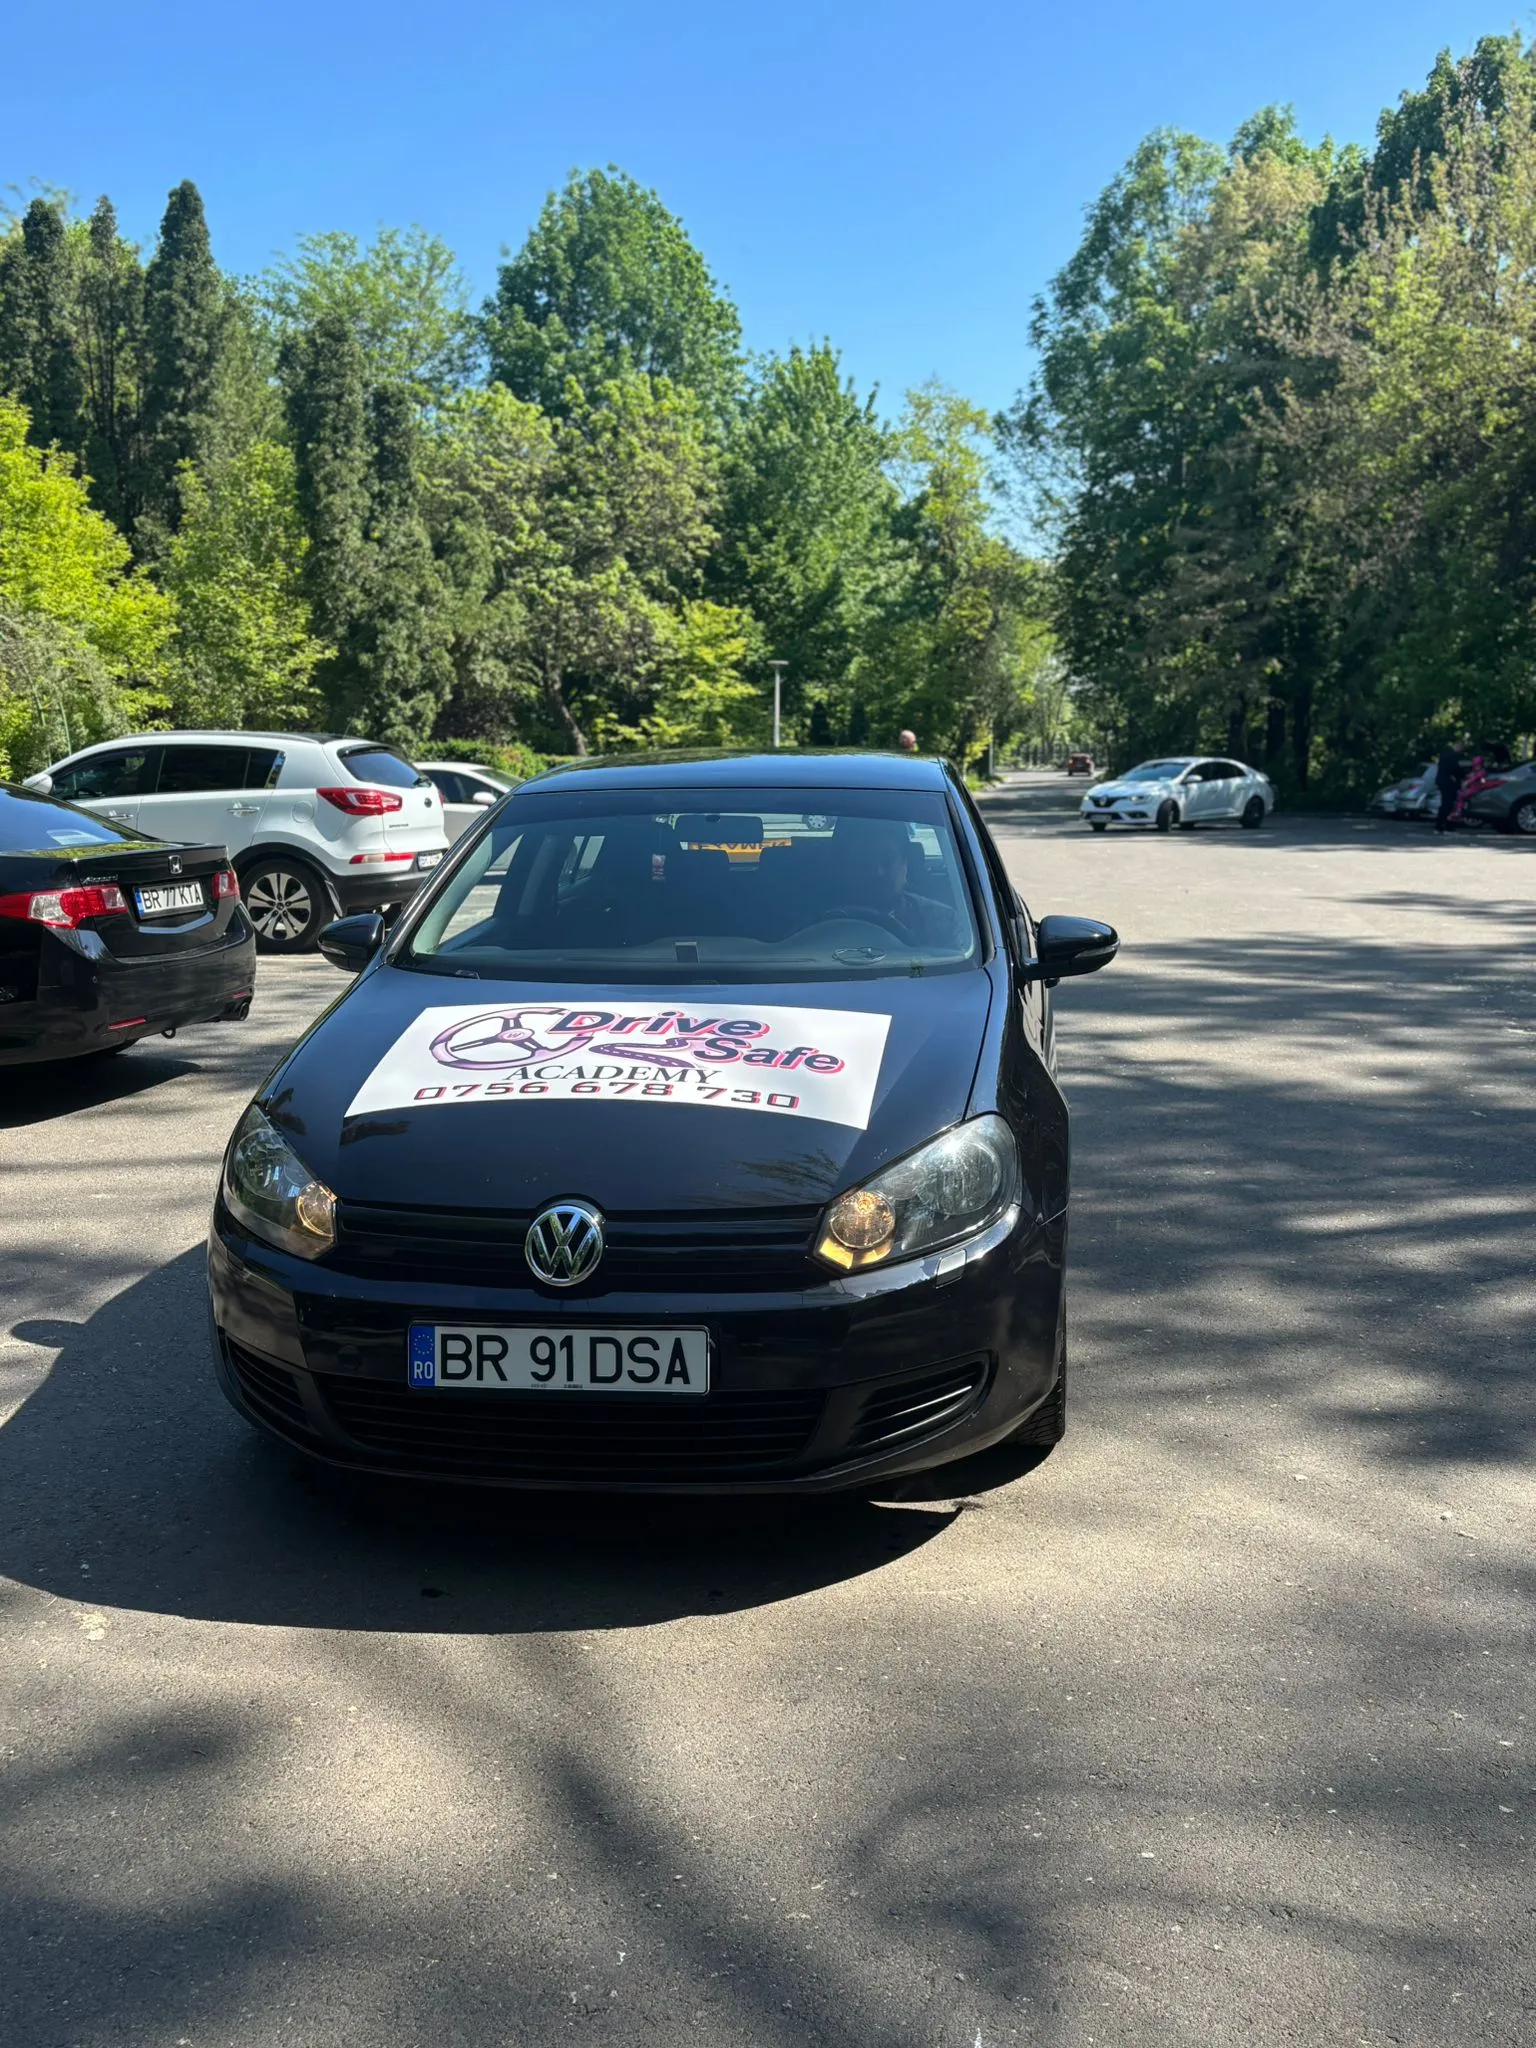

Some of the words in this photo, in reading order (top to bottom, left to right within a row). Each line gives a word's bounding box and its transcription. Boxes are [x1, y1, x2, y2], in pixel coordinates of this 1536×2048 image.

[142, 889, 161, 909] BR
[163, 887, 176, 907] 77
[177, 884, 202, 905] KTA
[546, 1011, 770, 1039] Drive
[693, 1037, 845, 1074] Safe
[502, 1065, 722, 1084] ACADEMY
[414, 1082, 549, 1100] 0756
[571, 1082, 674, 1096] 678
[697, 1086, 800, 1109] 730
[413, 1360, 434, 1380] RO
[440, 1333, 509, 1382] BR
[529, 1335, 575, 1383] 91
[589, 1336, 691, 1385] DSA
